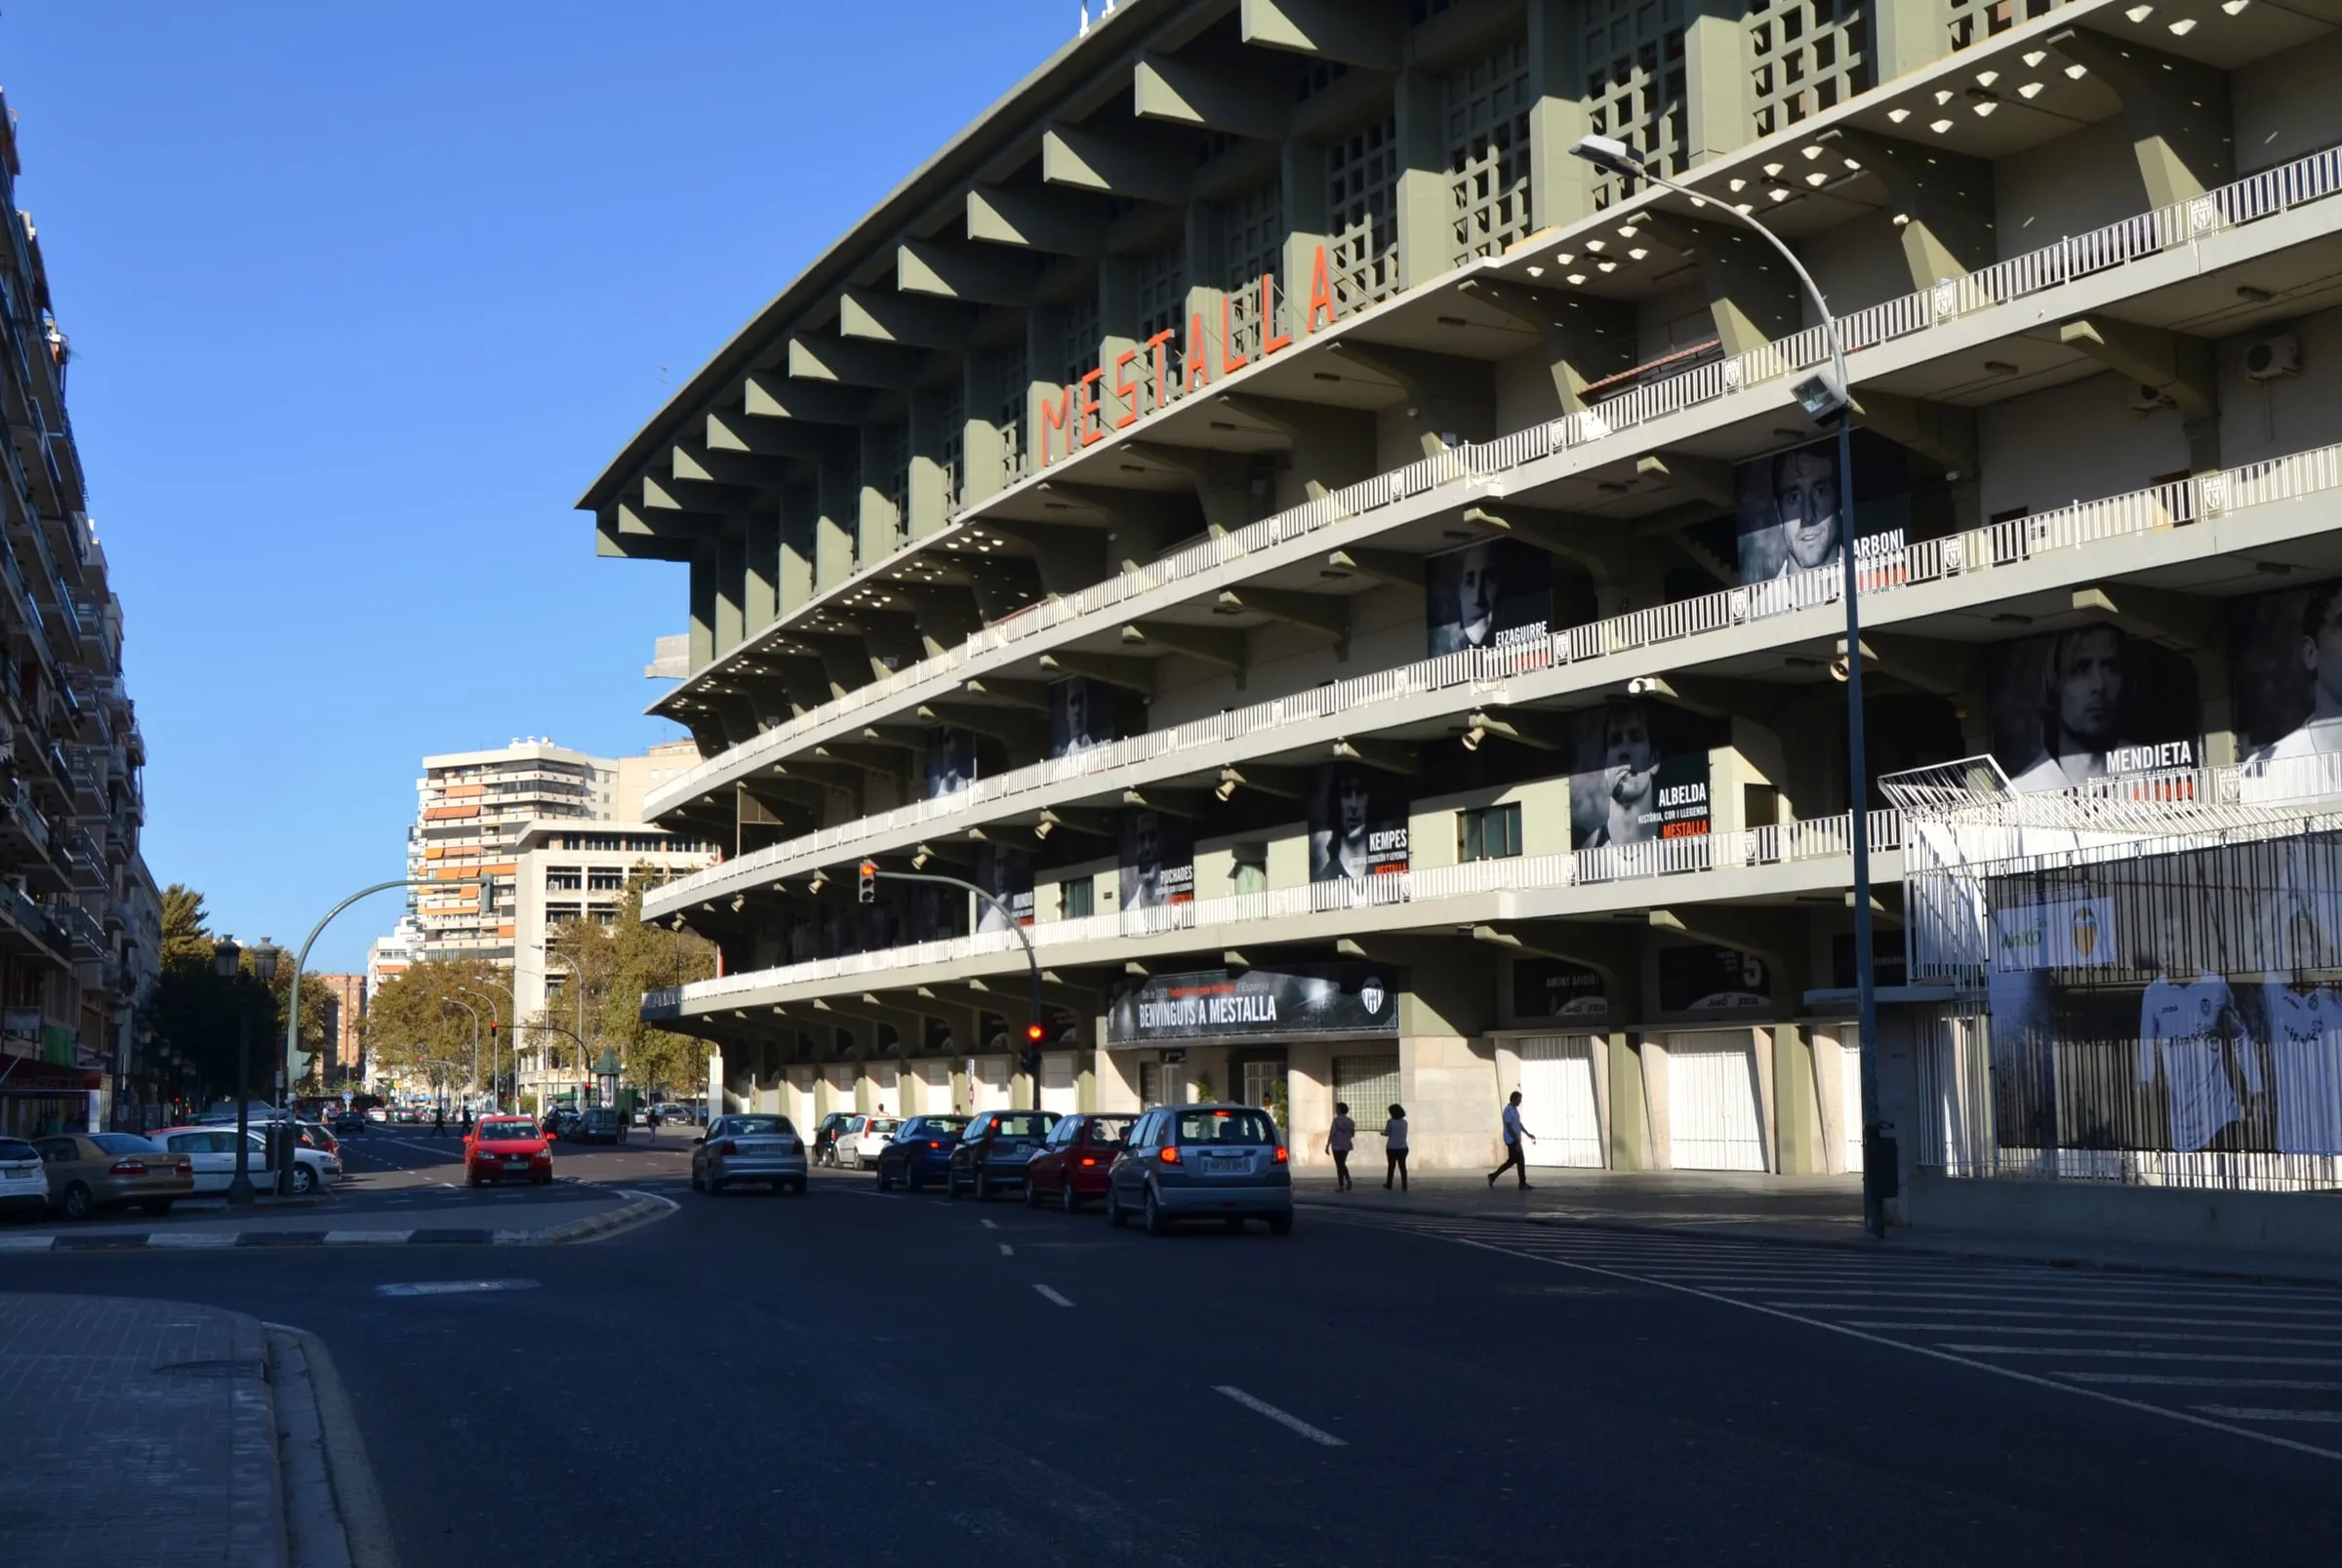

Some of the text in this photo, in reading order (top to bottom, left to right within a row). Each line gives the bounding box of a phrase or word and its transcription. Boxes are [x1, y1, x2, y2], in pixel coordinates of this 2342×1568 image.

[1041, 244, 1336, 467] MESTALLA
[1852, 529, 1905, 558] ARBONI
[1495, 621, 1548, 647] EIZAGUIRRE
[2106, 741, 2193, 773] MENDIETA
[1658, 784, 1707, 808] ALBELDA
[1664, 811, 1676, 821] COR
[1680, 806, 1708, 819] LLEGENDA
[1369, 828, 1407, 852] KEMPES
[1663, 820, 1708, 838] MESTALLA
[1160, 865, 1192, 885] PUCHADES
[1743, 955, 1762, 988] 5
[1139, 995, 1277, 1028] BENVINGUTS A MESTALLA
